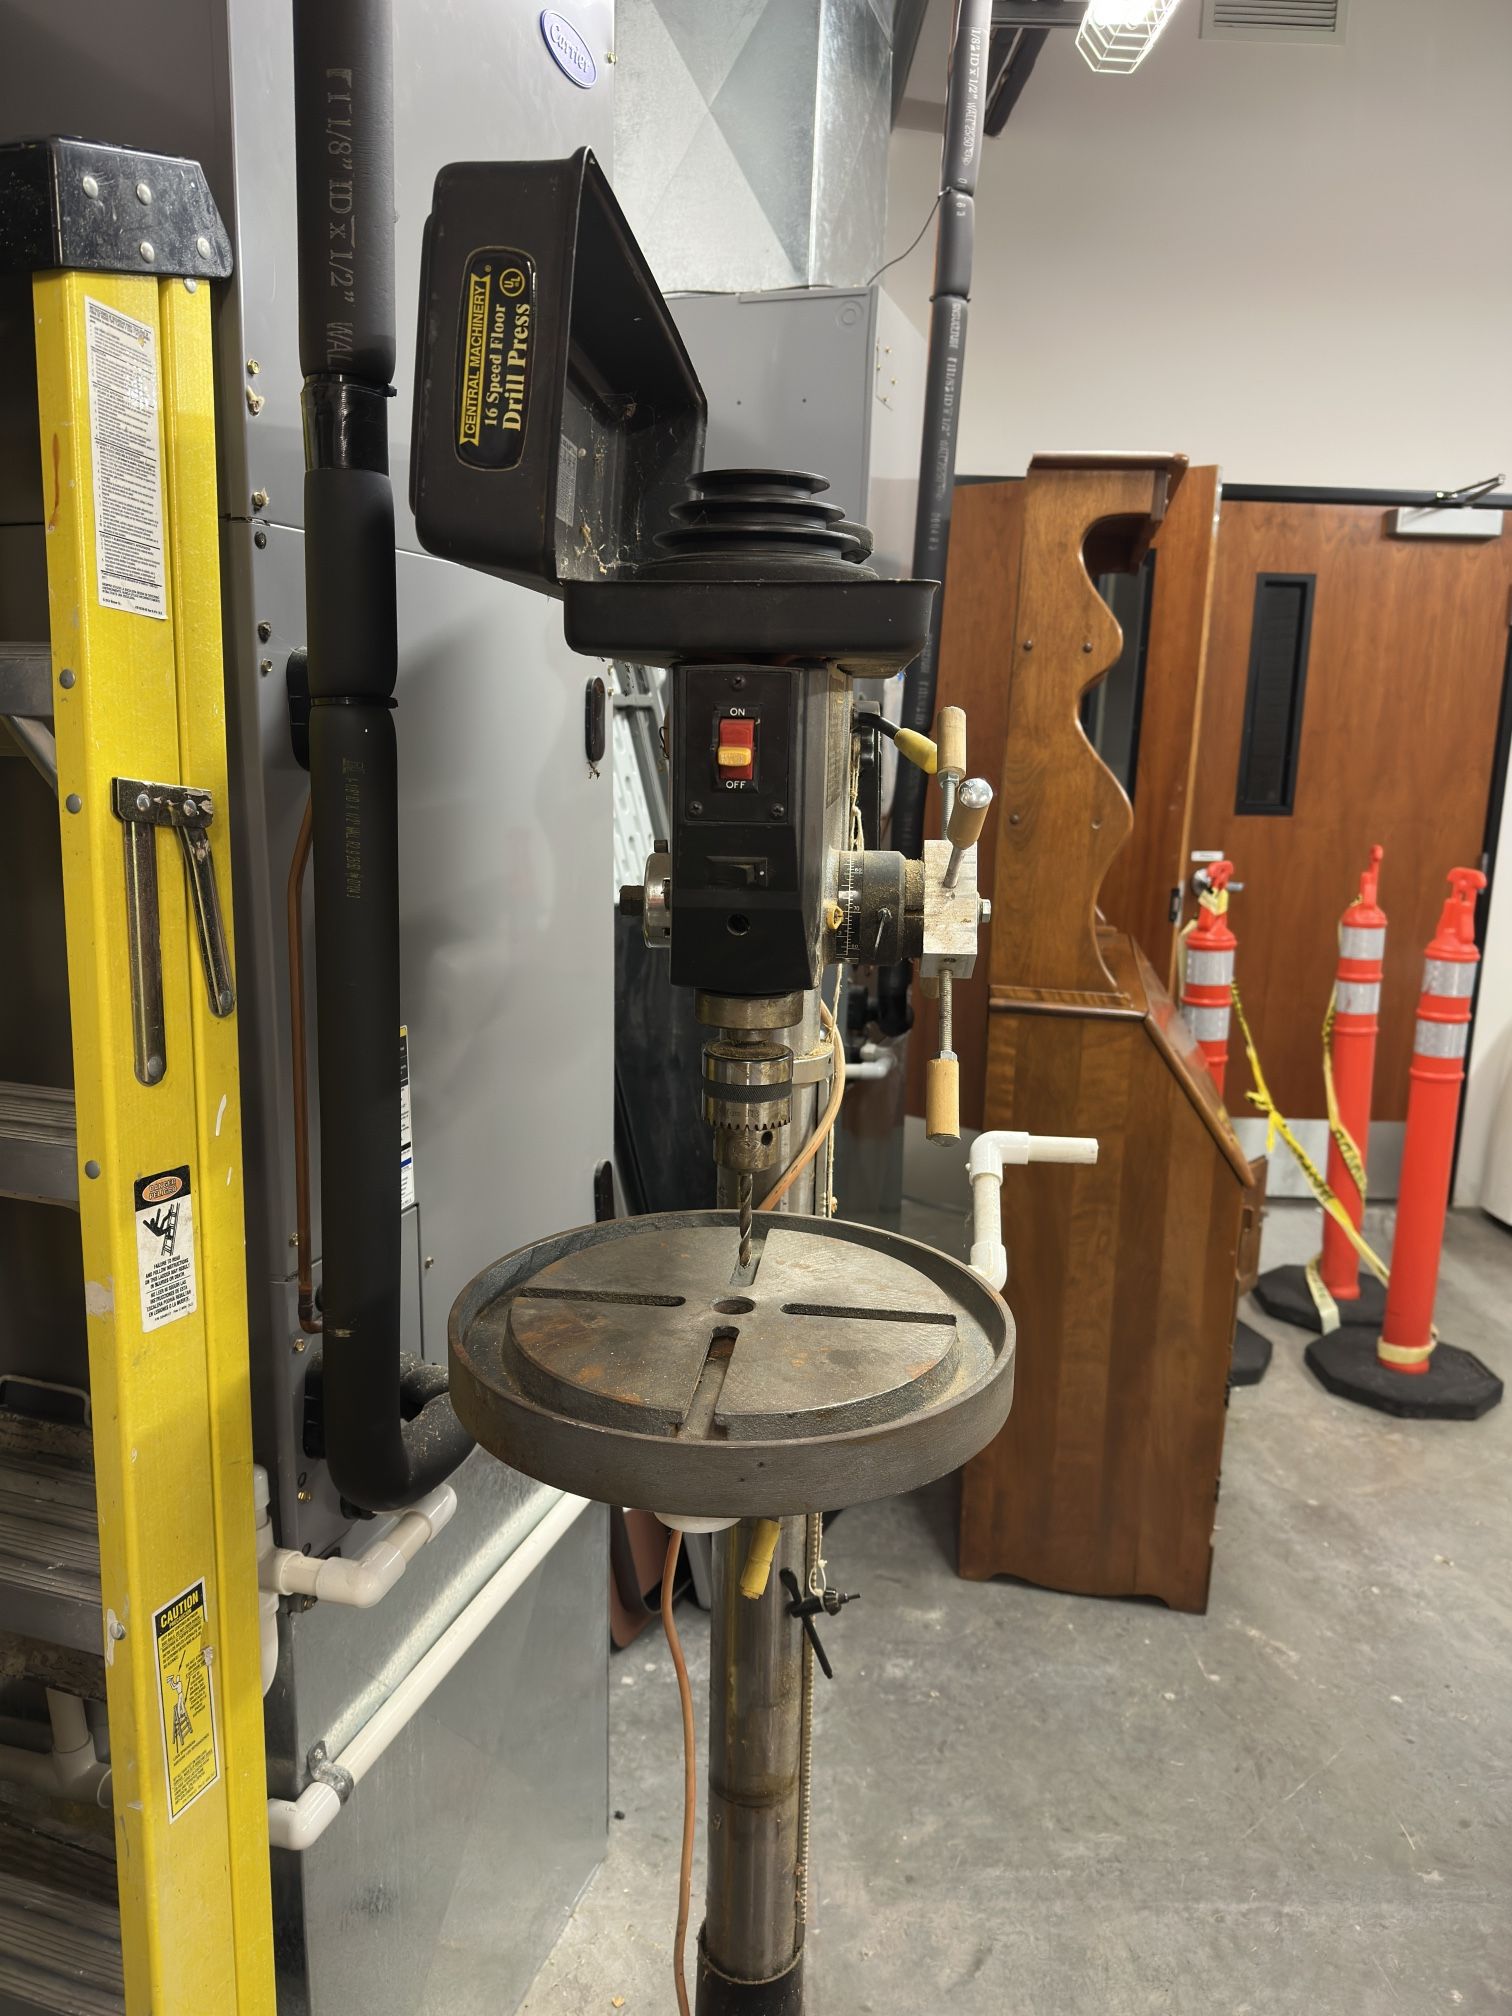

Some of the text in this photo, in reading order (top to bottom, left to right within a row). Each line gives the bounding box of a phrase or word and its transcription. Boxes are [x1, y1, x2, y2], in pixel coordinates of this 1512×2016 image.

[550, 23, 590, 74] Carrier
[329, 179, 353, 214] ID
[464, 286, 486, 434] CENTRAL MACHINERY
[485, 304, 506, 426] 16 Speed Floor
[502, 303, 531, 432] Drill Press
[729, 708, 745, 716] ON
[725, 780, 746, 789] OFF
[161, 1590, 199, 1628] CAUTION
